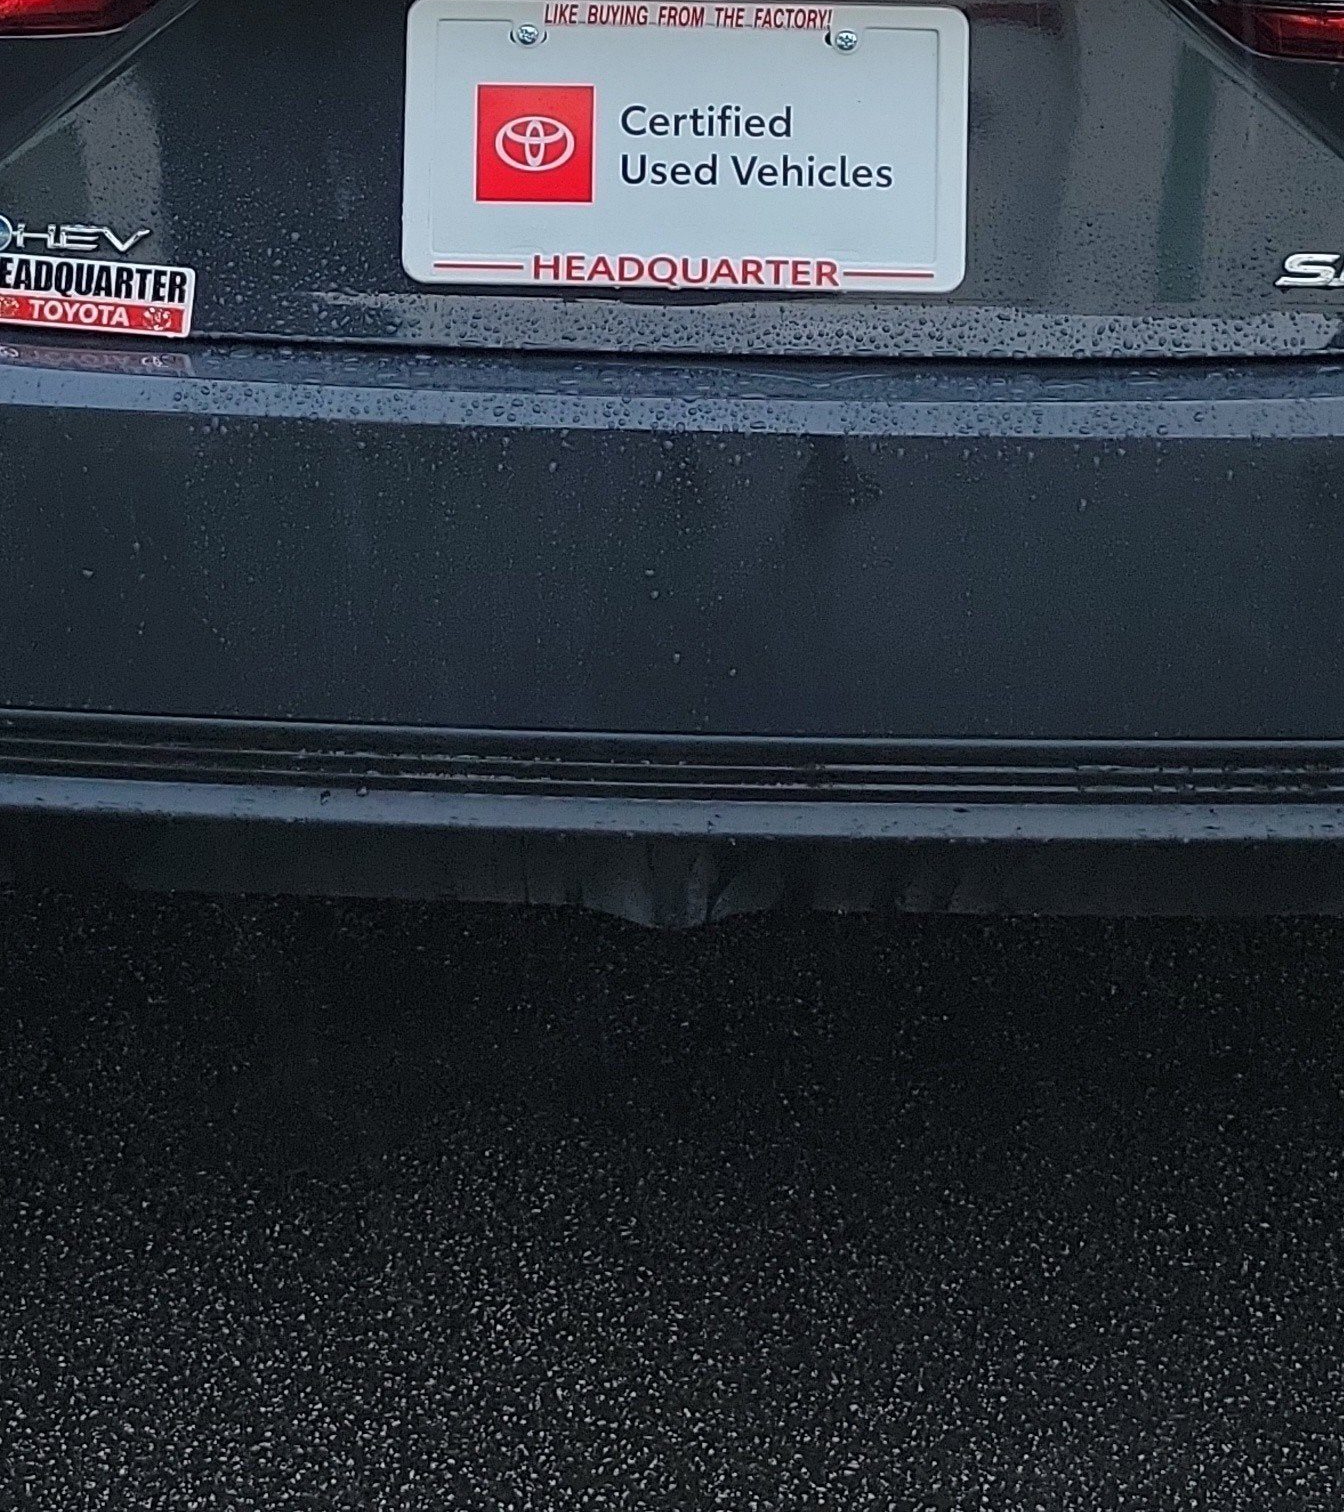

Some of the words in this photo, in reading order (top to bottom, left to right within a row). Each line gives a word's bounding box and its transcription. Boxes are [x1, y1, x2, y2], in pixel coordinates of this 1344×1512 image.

[544, 3, 579, 24] LIKE
[587, 4, 649, 26] BUYING
[657, 5, 706, 27] FROM
[714, 7, 746, 28] THE
[754, 7, 833, 29] FACTORY!
[620, 104, 792, 138] Certified
[621, 153, 718, 186] Used
[730, 153, 893, 188] Vehicles
[16, 222, 151, 253] HEV
[532, 253, 840, 287] HEADQUARTER
[28, 298, 131, 328] TOYOTA
